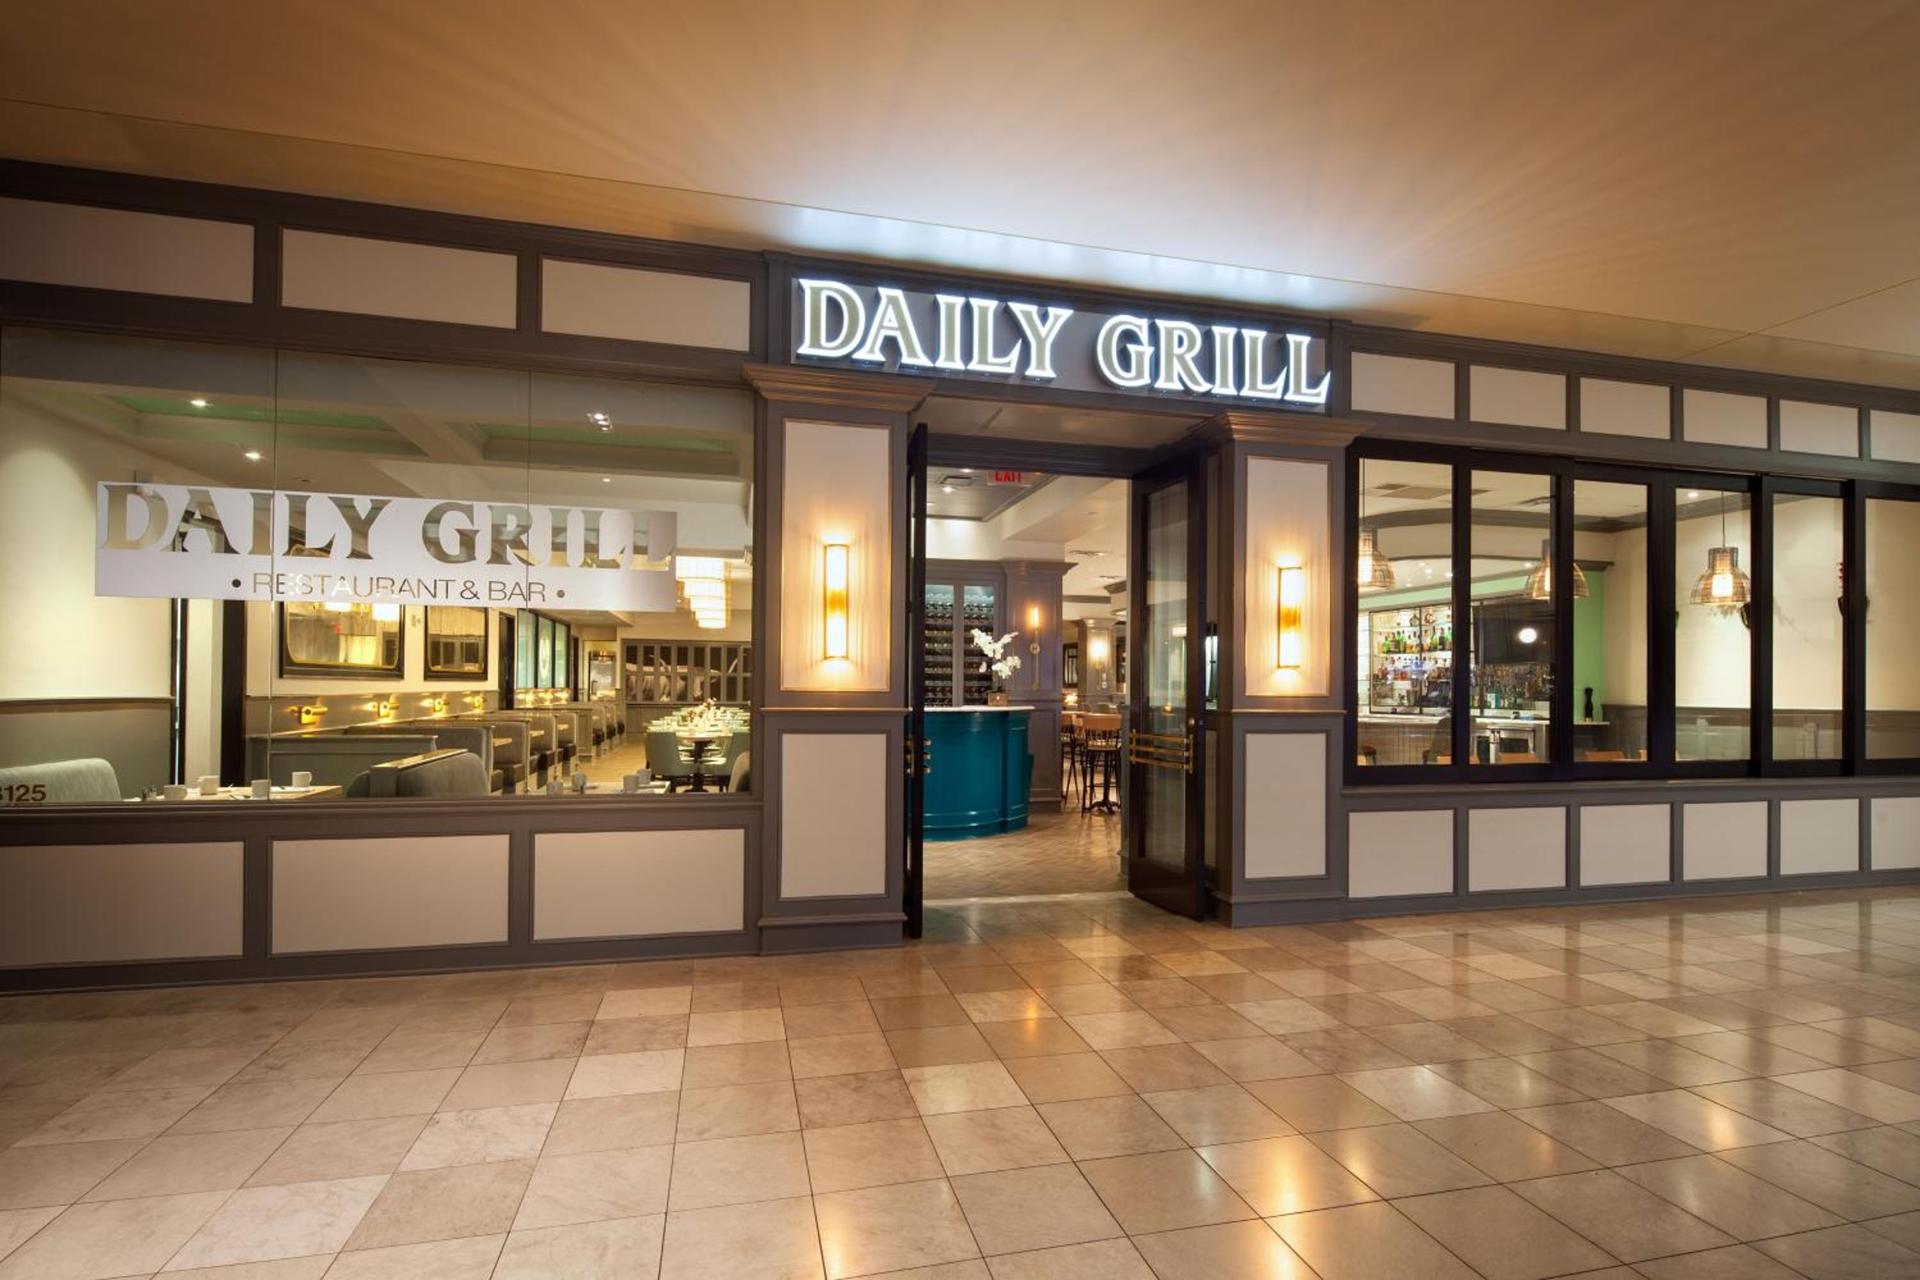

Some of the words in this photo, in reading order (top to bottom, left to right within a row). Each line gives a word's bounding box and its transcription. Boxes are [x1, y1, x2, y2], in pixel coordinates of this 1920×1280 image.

[797, 277, 1075, 382] DAILY
[1096, 313, 1333, 405] GRILL
[100, 484, 393, 561] DAILY
[422, 501, 676, 572] GRILL
[488, 580, 546, 602] BAR
[0, 784, 47, 802] 125
